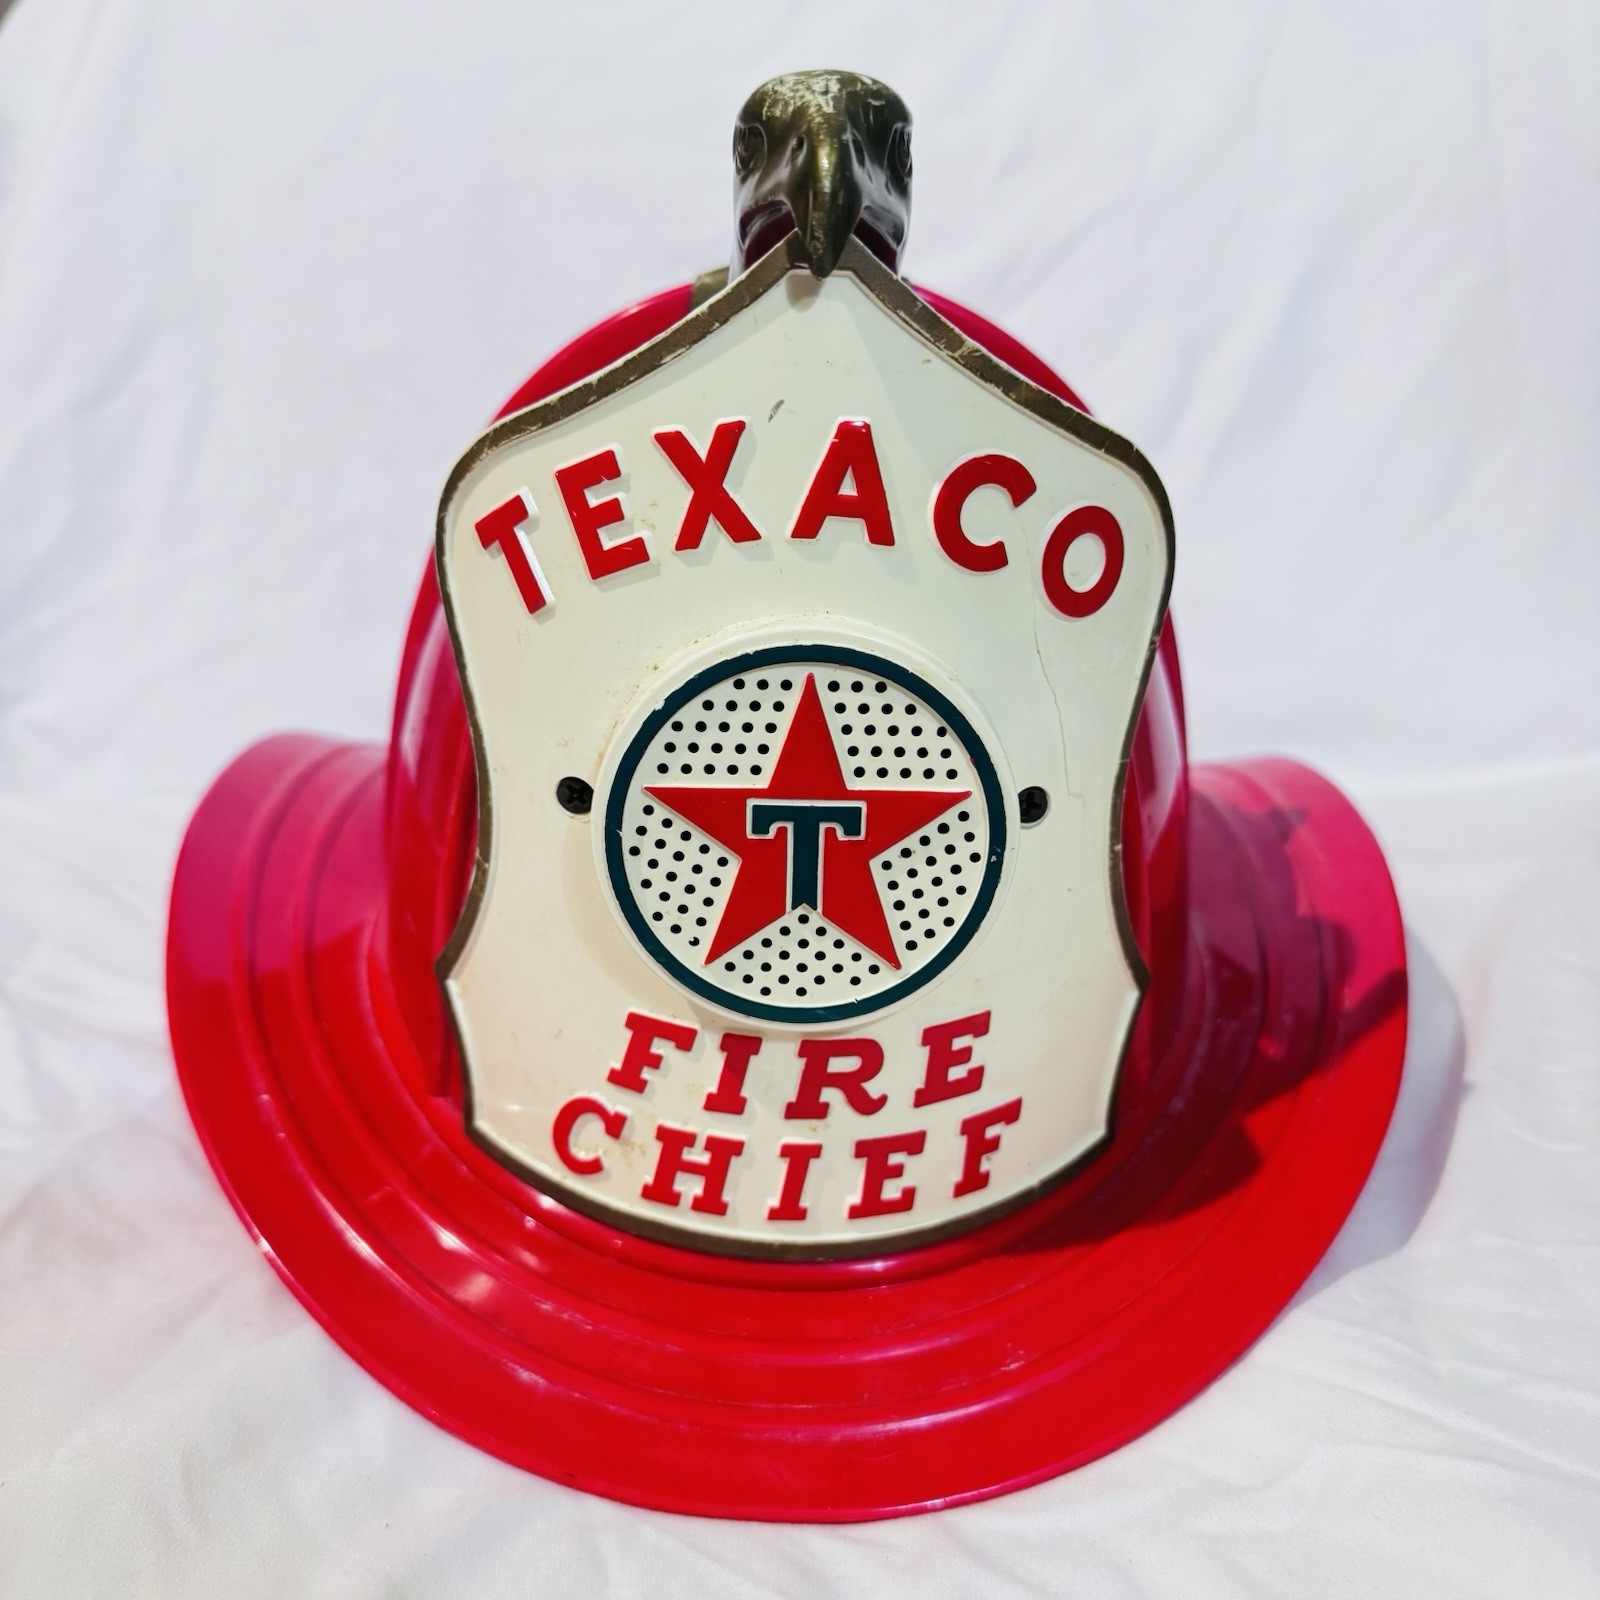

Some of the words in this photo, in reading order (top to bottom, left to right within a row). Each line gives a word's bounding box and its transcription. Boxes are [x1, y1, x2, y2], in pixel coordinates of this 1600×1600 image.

[473, 418, 1124, 618] TEXACO
[748, 802, 865, 912] T
[606, 1010, 991, 1121] FIRE
[551, 1095, 1023, 1222] CHIEF
